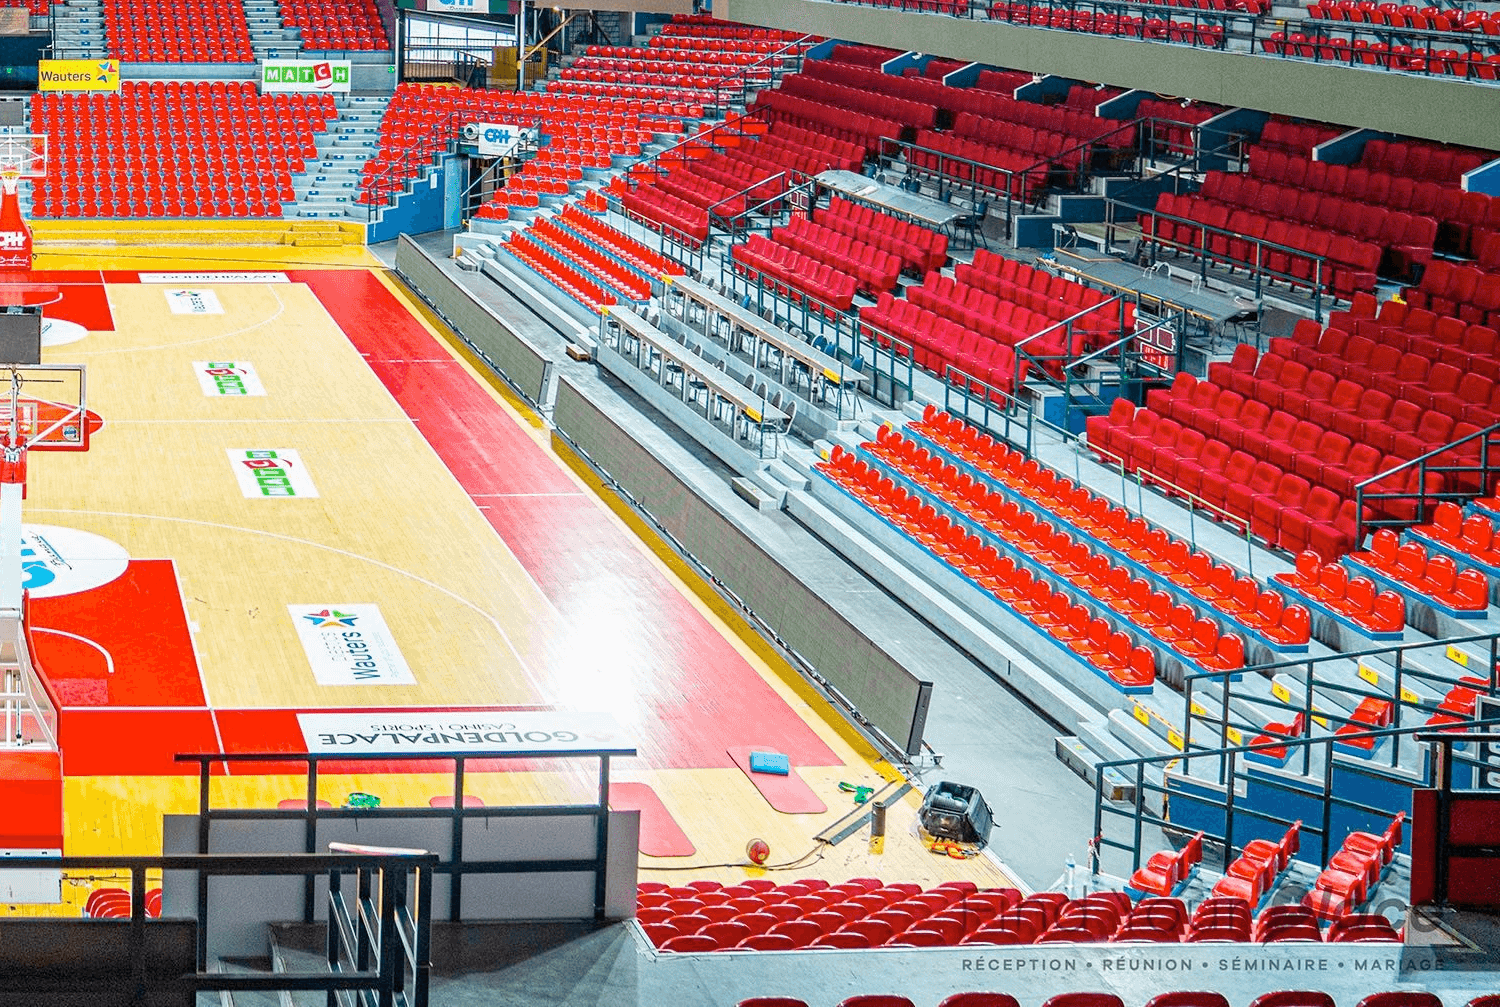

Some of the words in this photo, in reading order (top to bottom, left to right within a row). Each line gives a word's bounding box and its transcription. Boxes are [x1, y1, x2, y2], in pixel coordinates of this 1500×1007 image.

[41, 71, 91, 82] Wauters
[266, 64, 346, 82] MATCH
[484, 128, 511, 145] CPH
[342, 632, 381, 680] Wauters
[371, 724, 434, 732] SPORTS
[448, 723, 516, 731] CASINO
[321, 731, 579, 746] GOLDENPALACE
